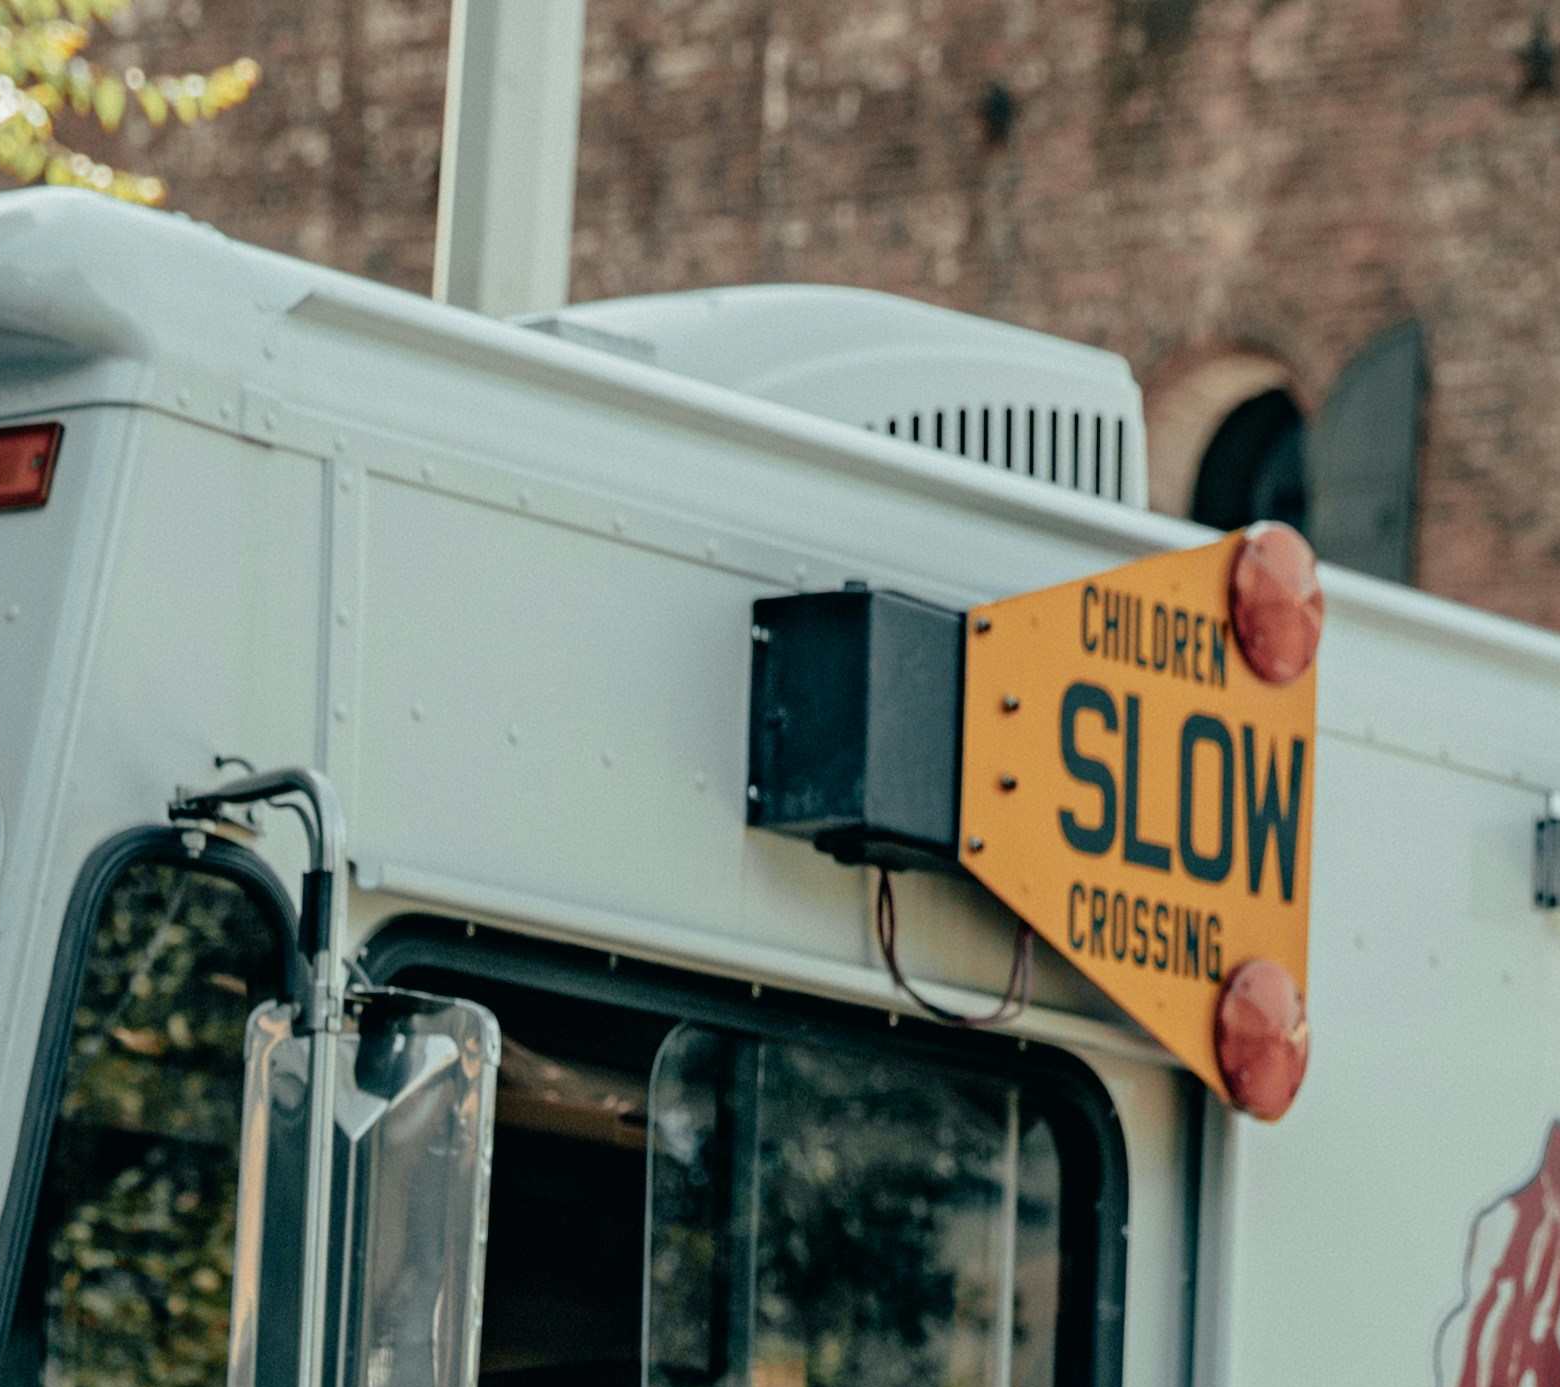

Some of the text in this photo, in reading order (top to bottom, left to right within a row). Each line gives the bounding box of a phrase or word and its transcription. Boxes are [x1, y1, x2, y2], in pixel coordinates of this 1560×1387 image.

[1080, 584, 1227, 688] CHILDREN
[1057, 681, 1306, 903] SLOW
[1067, 883, 1222, 983] CROSSING
